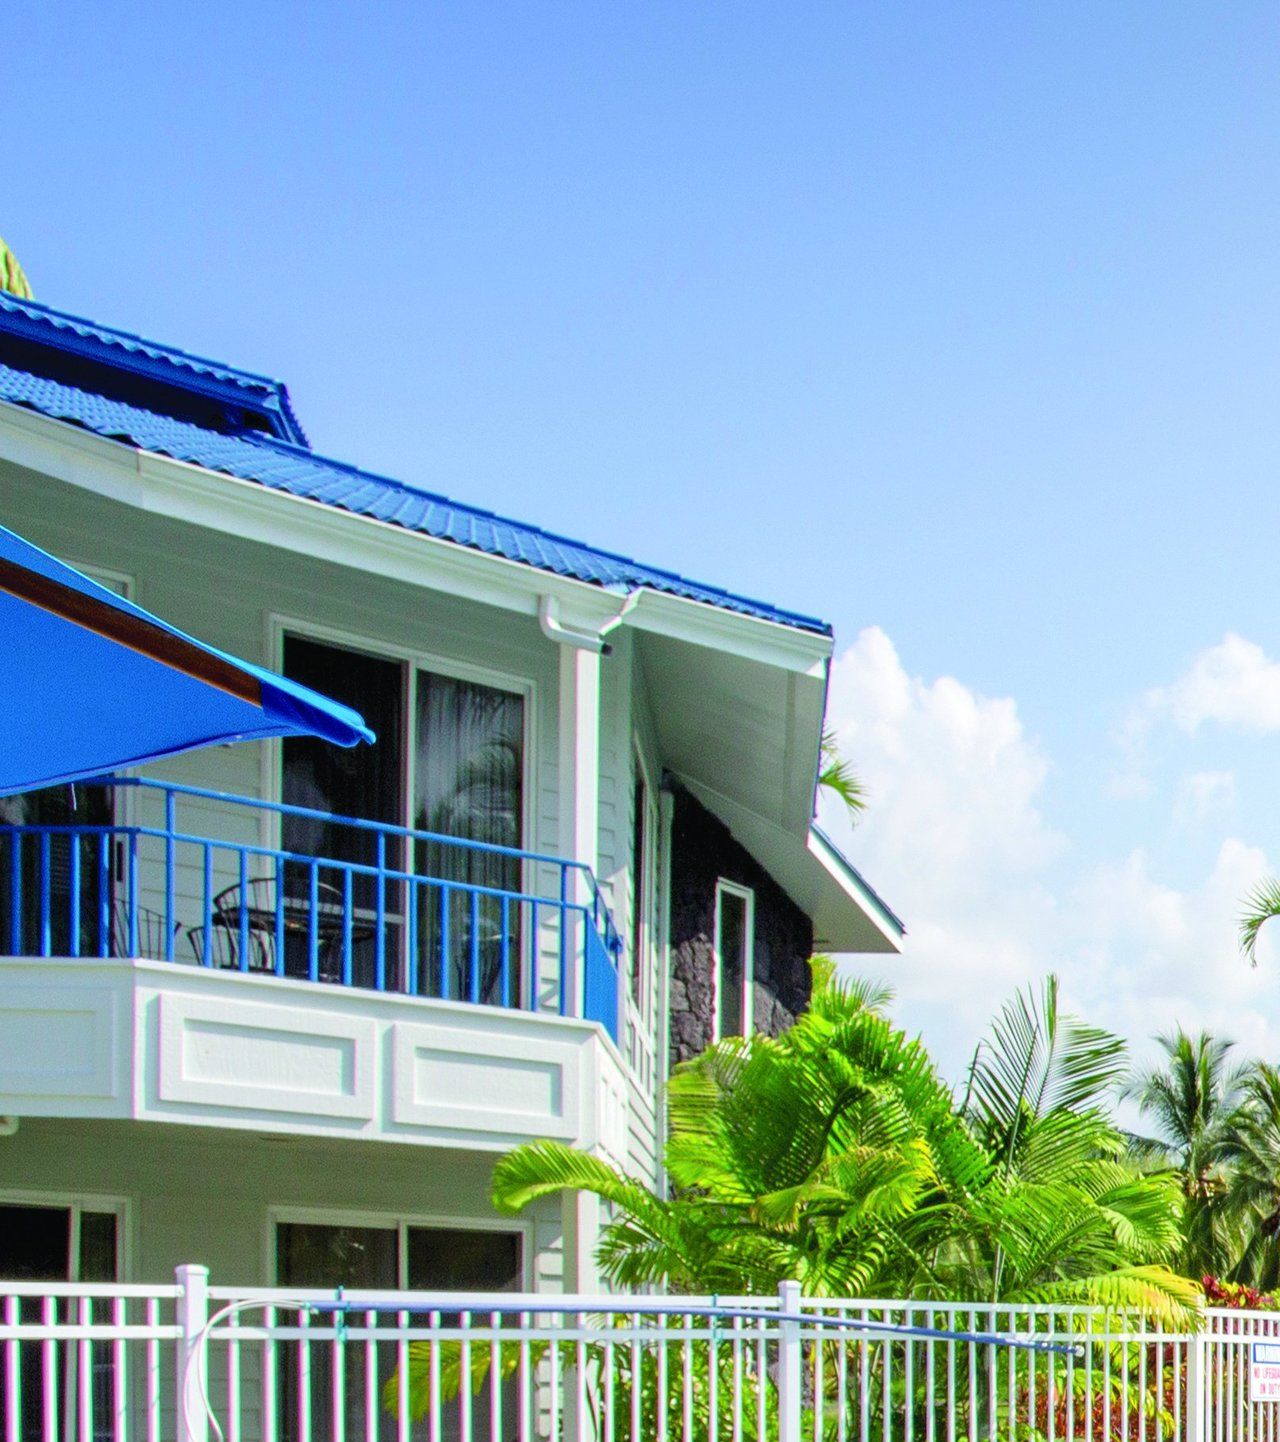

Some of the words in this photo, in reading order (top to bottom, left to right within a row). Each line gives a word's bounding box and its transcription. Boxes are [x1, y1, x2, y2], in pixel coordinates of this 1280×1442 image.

[1253, 1367, 1260, 1379] NO
[1260, 1383, 1266, 1394] ON
[1268, 1383, 1280, 1395] DUTY
